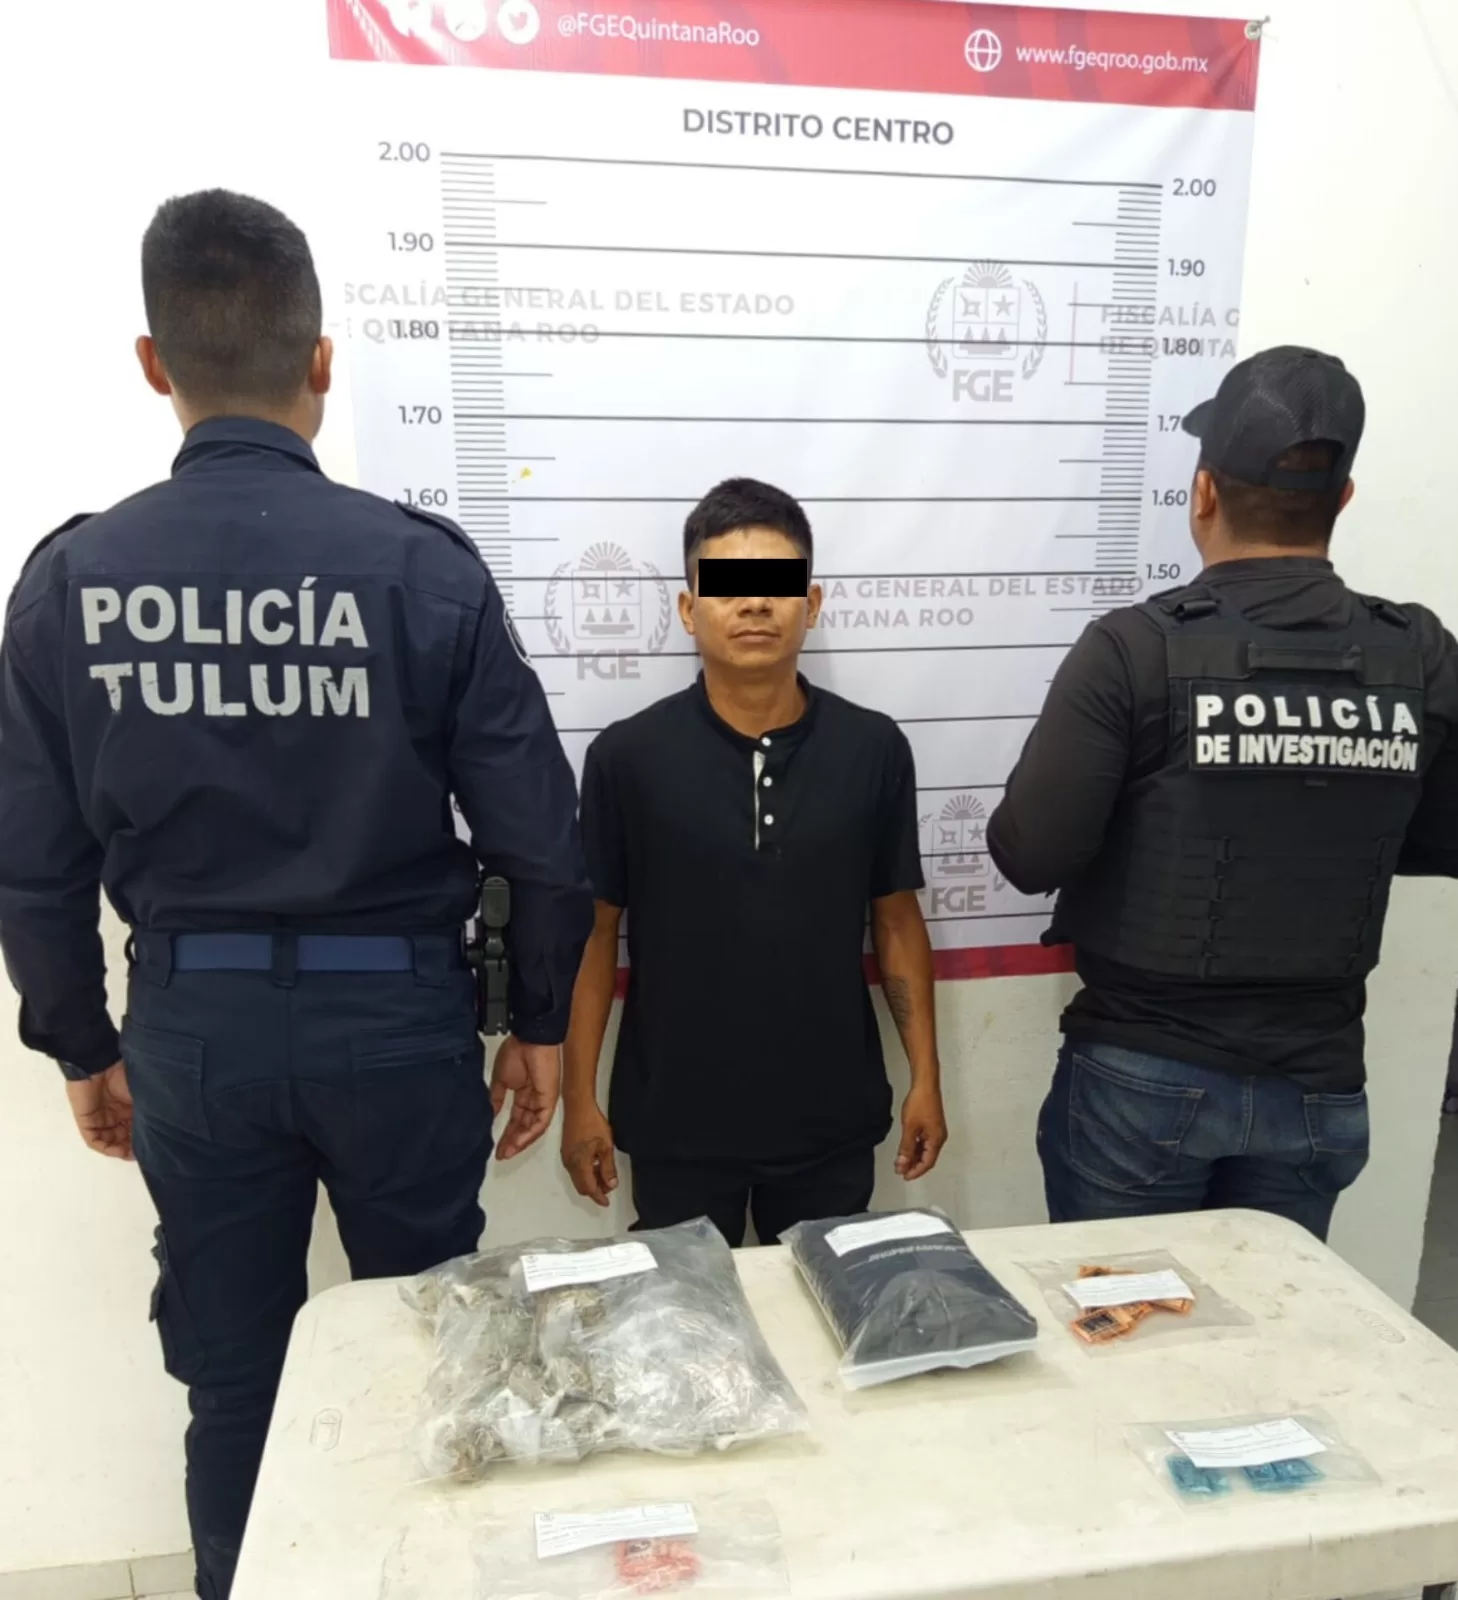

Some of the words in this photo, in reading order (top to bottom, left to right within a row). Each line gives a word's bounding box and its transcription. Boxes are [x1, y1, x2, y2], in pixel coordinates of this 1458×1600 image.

[557, 12, 760, 46] @FGEQuintanaRoo
[1016, 45, 1208, 74] www.fgeqroo.gob.mx
[683, 108, 823, 138] DISTRITO
[833, 116, 954, 145] CENTRO
[378, 142, 431, 162] 2.00
[1172, 179, 1216, 197] 2.00
[387, 232, 434, 252] 1.90
[1167, 259, 1205, 277] 1.90
[461, 286, 604, 311] GENERAL
[615, 289, 670, 313] DEL
[679, 292, 795, 316] ESTADO
[392, 319, 439, 339] 1.80
[537, 322, 600, 344] ROO
[1162, 336, 1200, 356] 1.80
[952, 370, 1014, 402] FGE
[398, 405, 442, 425] 1.70
[1157, 414, 1182, 432] 1.7
[403, 488, 448, 508] 1.60
[1152, 489, 1188, 506] 1.60
[1146, 563, 1180, 580] 1.50
[856, 577, 978, 599] GENERAL
[988, 576, 1036, 597] DEL
[1045, 575, 1143, 597] ESTADO
[80, 577, 369, 648] POLICÍA
[820, 608, 910, 629] NTANA
[919, 608, 973, 628] ROO
[576, 649, 640, 680] FGE
[90, 662, 369, 717] TULUM
[1196, 694, 1418, 735] POLICÍA
[1196, 734, 1230, 763] DE
[1238, 734, 1418, 771] INVESTIGACIÓN
[931, 884, 987, 914] FGE
